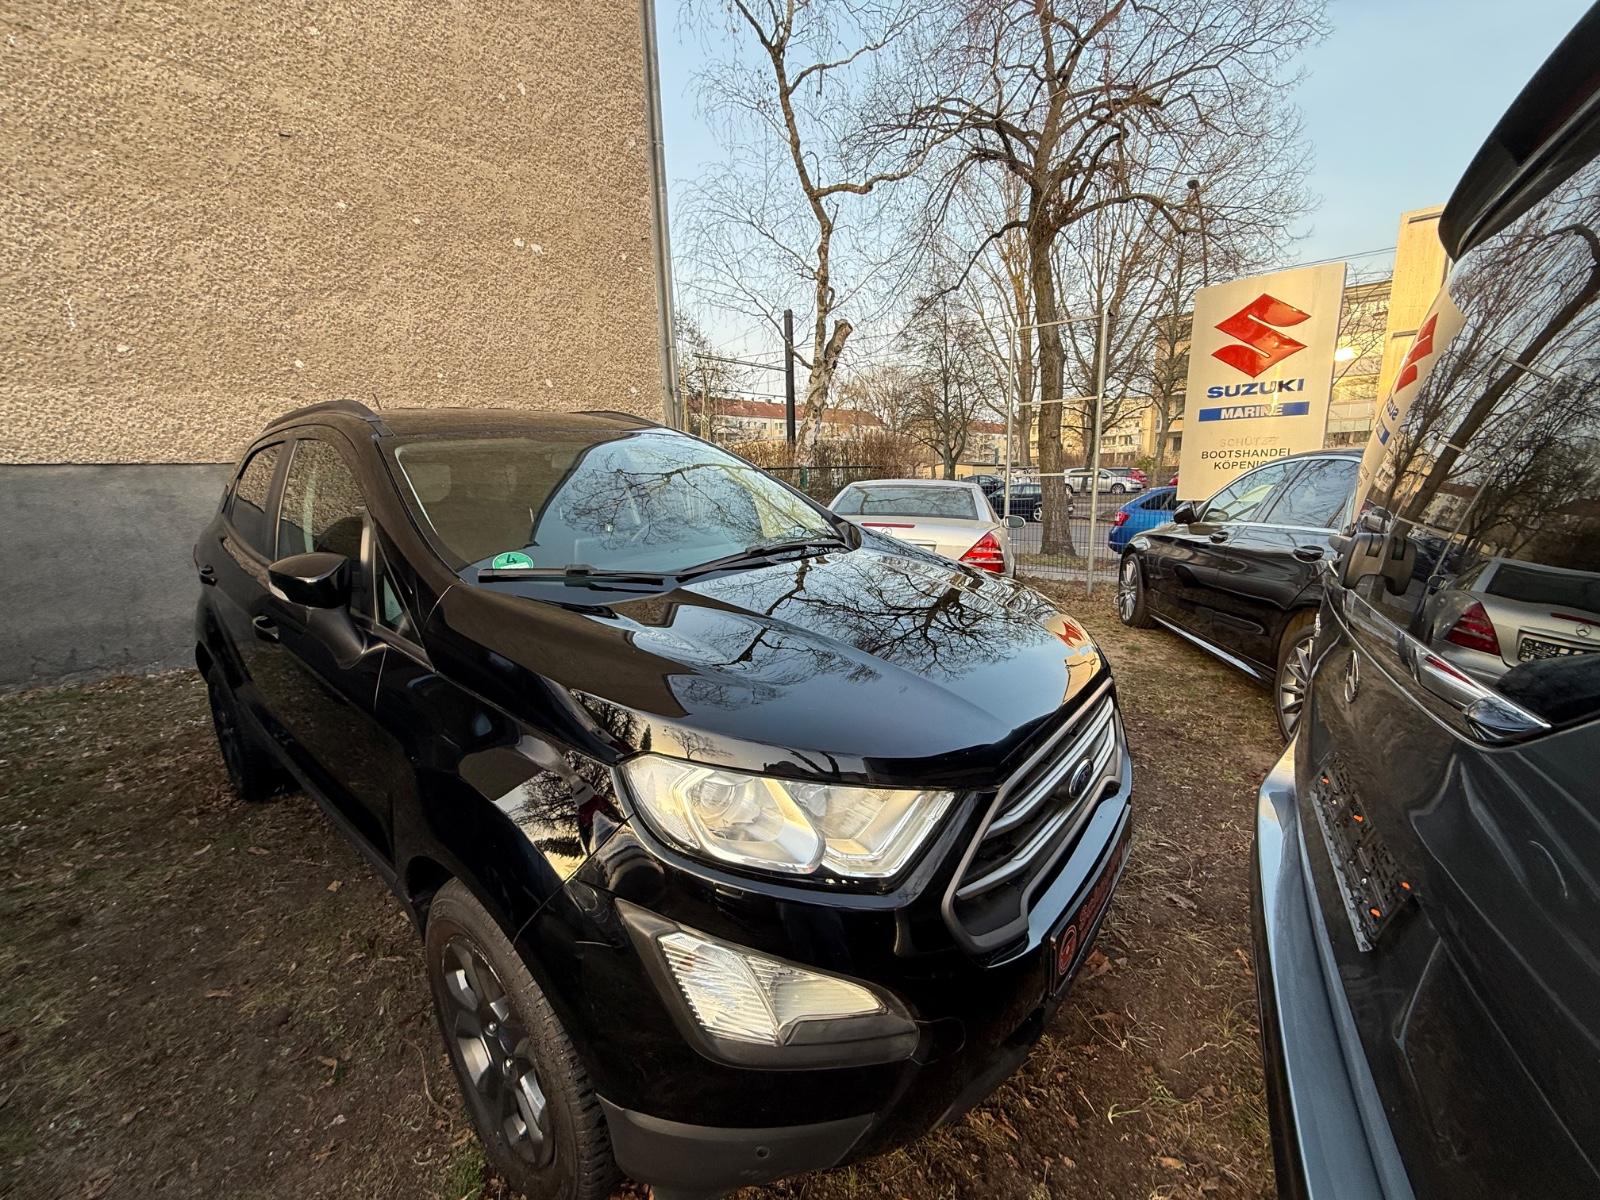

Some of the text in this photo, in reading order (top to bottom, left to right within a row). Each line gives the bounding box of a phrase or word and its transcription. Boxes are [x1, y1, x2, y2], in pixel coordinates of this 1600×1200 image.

[1207, 378, 1305, 399] SUZUKI
[1220, 404, 1284, 420] MARINE
[1201, 447, 1291, 459] BOOTSHANDEL
[506, 554, 518, 564] 4
